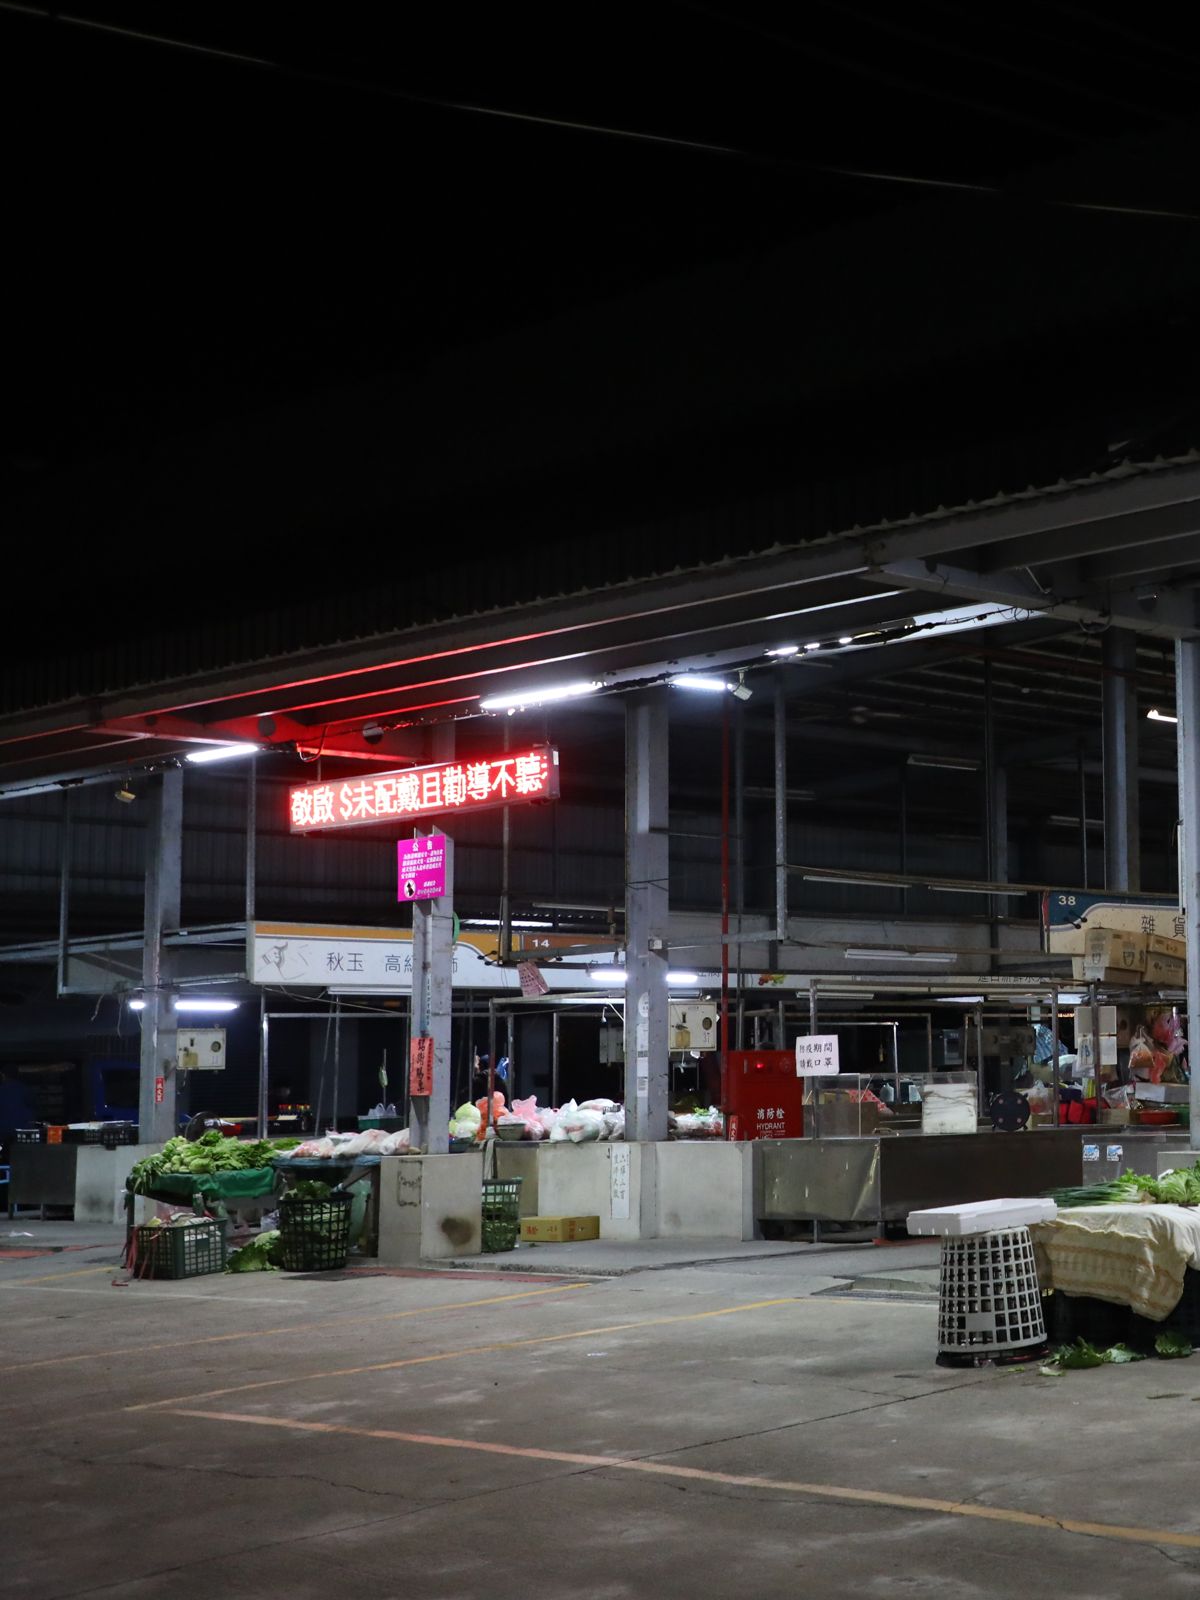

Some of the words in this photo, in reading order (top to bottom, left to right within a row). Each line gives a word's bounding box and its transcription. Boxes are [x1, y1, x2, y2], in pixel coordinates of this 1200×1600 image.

[290, 786, 335, 826] 敬啟
[1058, 895, 1076, 906] 38
[1141, 915, 1185, 938] 雜貨
[532, 939, 550, 948] 14
[326, 951, 365, 971] 秋玉
[799, 1042, 833, 1053] 防疫期間
[757, 1107, 785, 1120] 消防栓
[756, 1122, 785, 1130] HYDRANT
